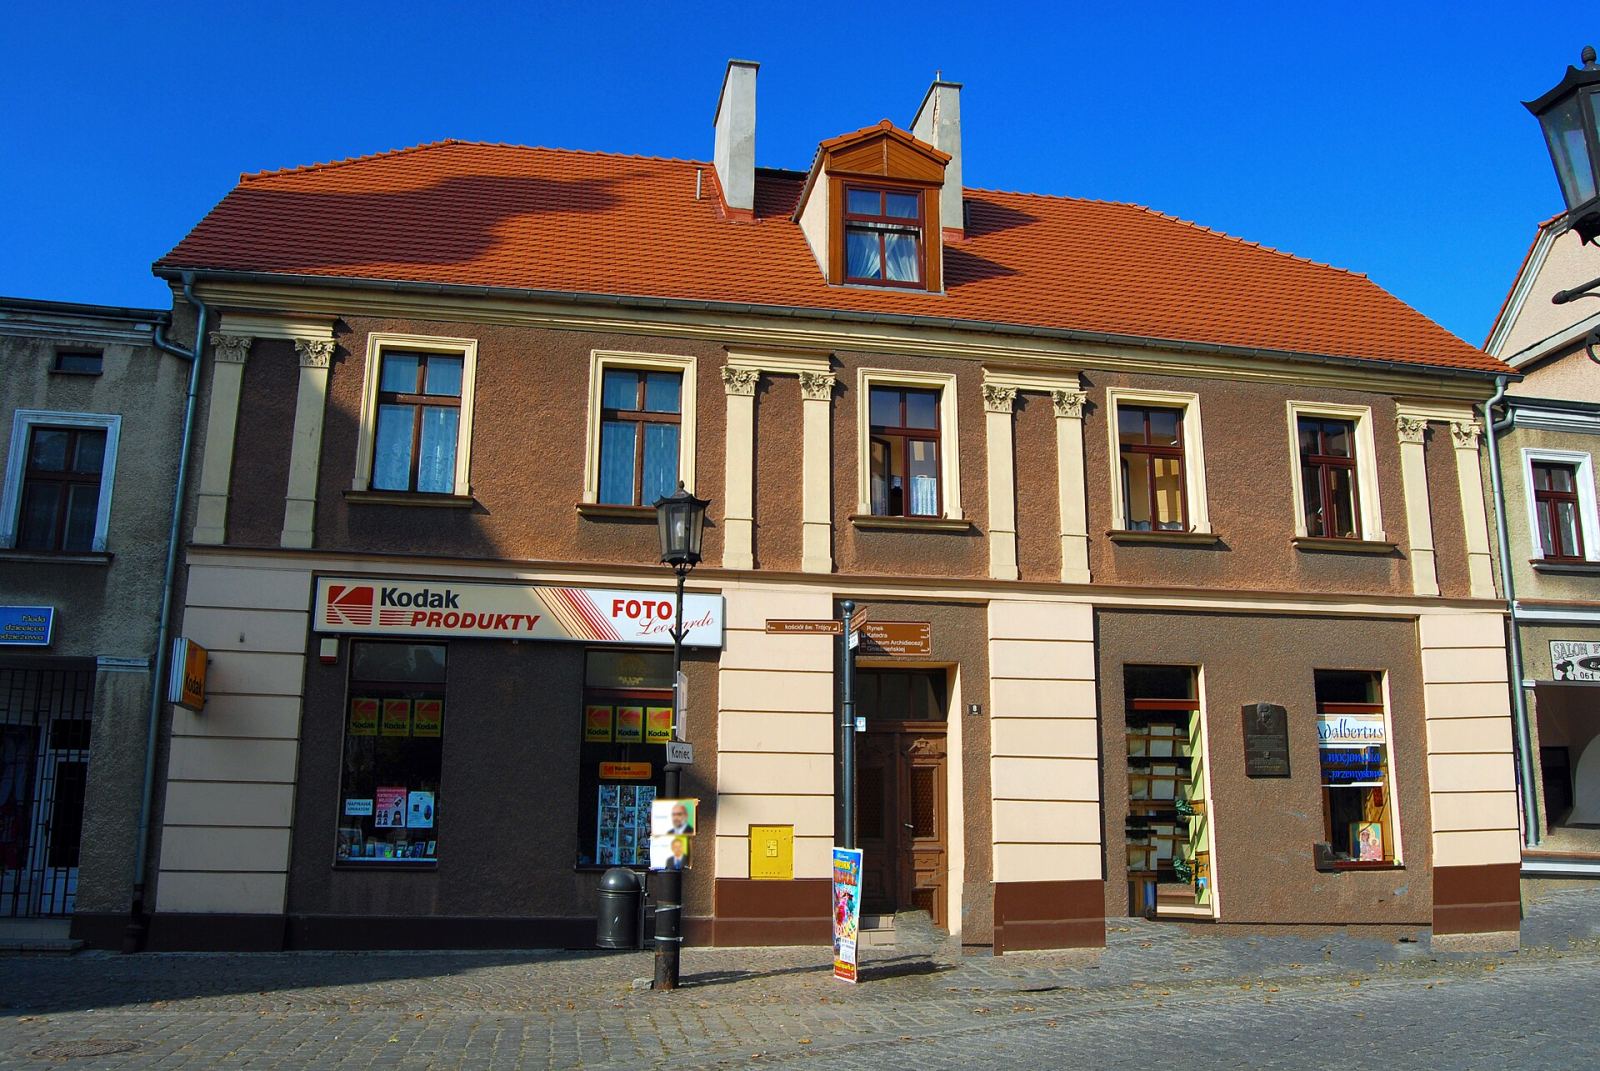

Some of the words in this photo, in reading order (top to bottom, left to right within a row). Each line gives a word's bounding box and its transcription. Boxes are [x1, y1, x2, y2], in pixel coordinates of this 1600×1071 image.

[380, 587, 459, 609] Kodak
[612, 599, 673, 620] FOTO
[410, 610, 541, 631] PRODUKTY
[1553, 642, 1588, 660] SALON
[185, 672, 203, 697] Kodak
[352, 721, 374, 729] Kodak
[384, 721, 406, 729] Kodak
[415, 722, 438, 730] Kodak
[587, 727, 608, 735] Kodak
[617, 728, 640, 736] Kodak
[648, 729, 670, 737] Kodak
[672, 745, 690, 759] Koniec
